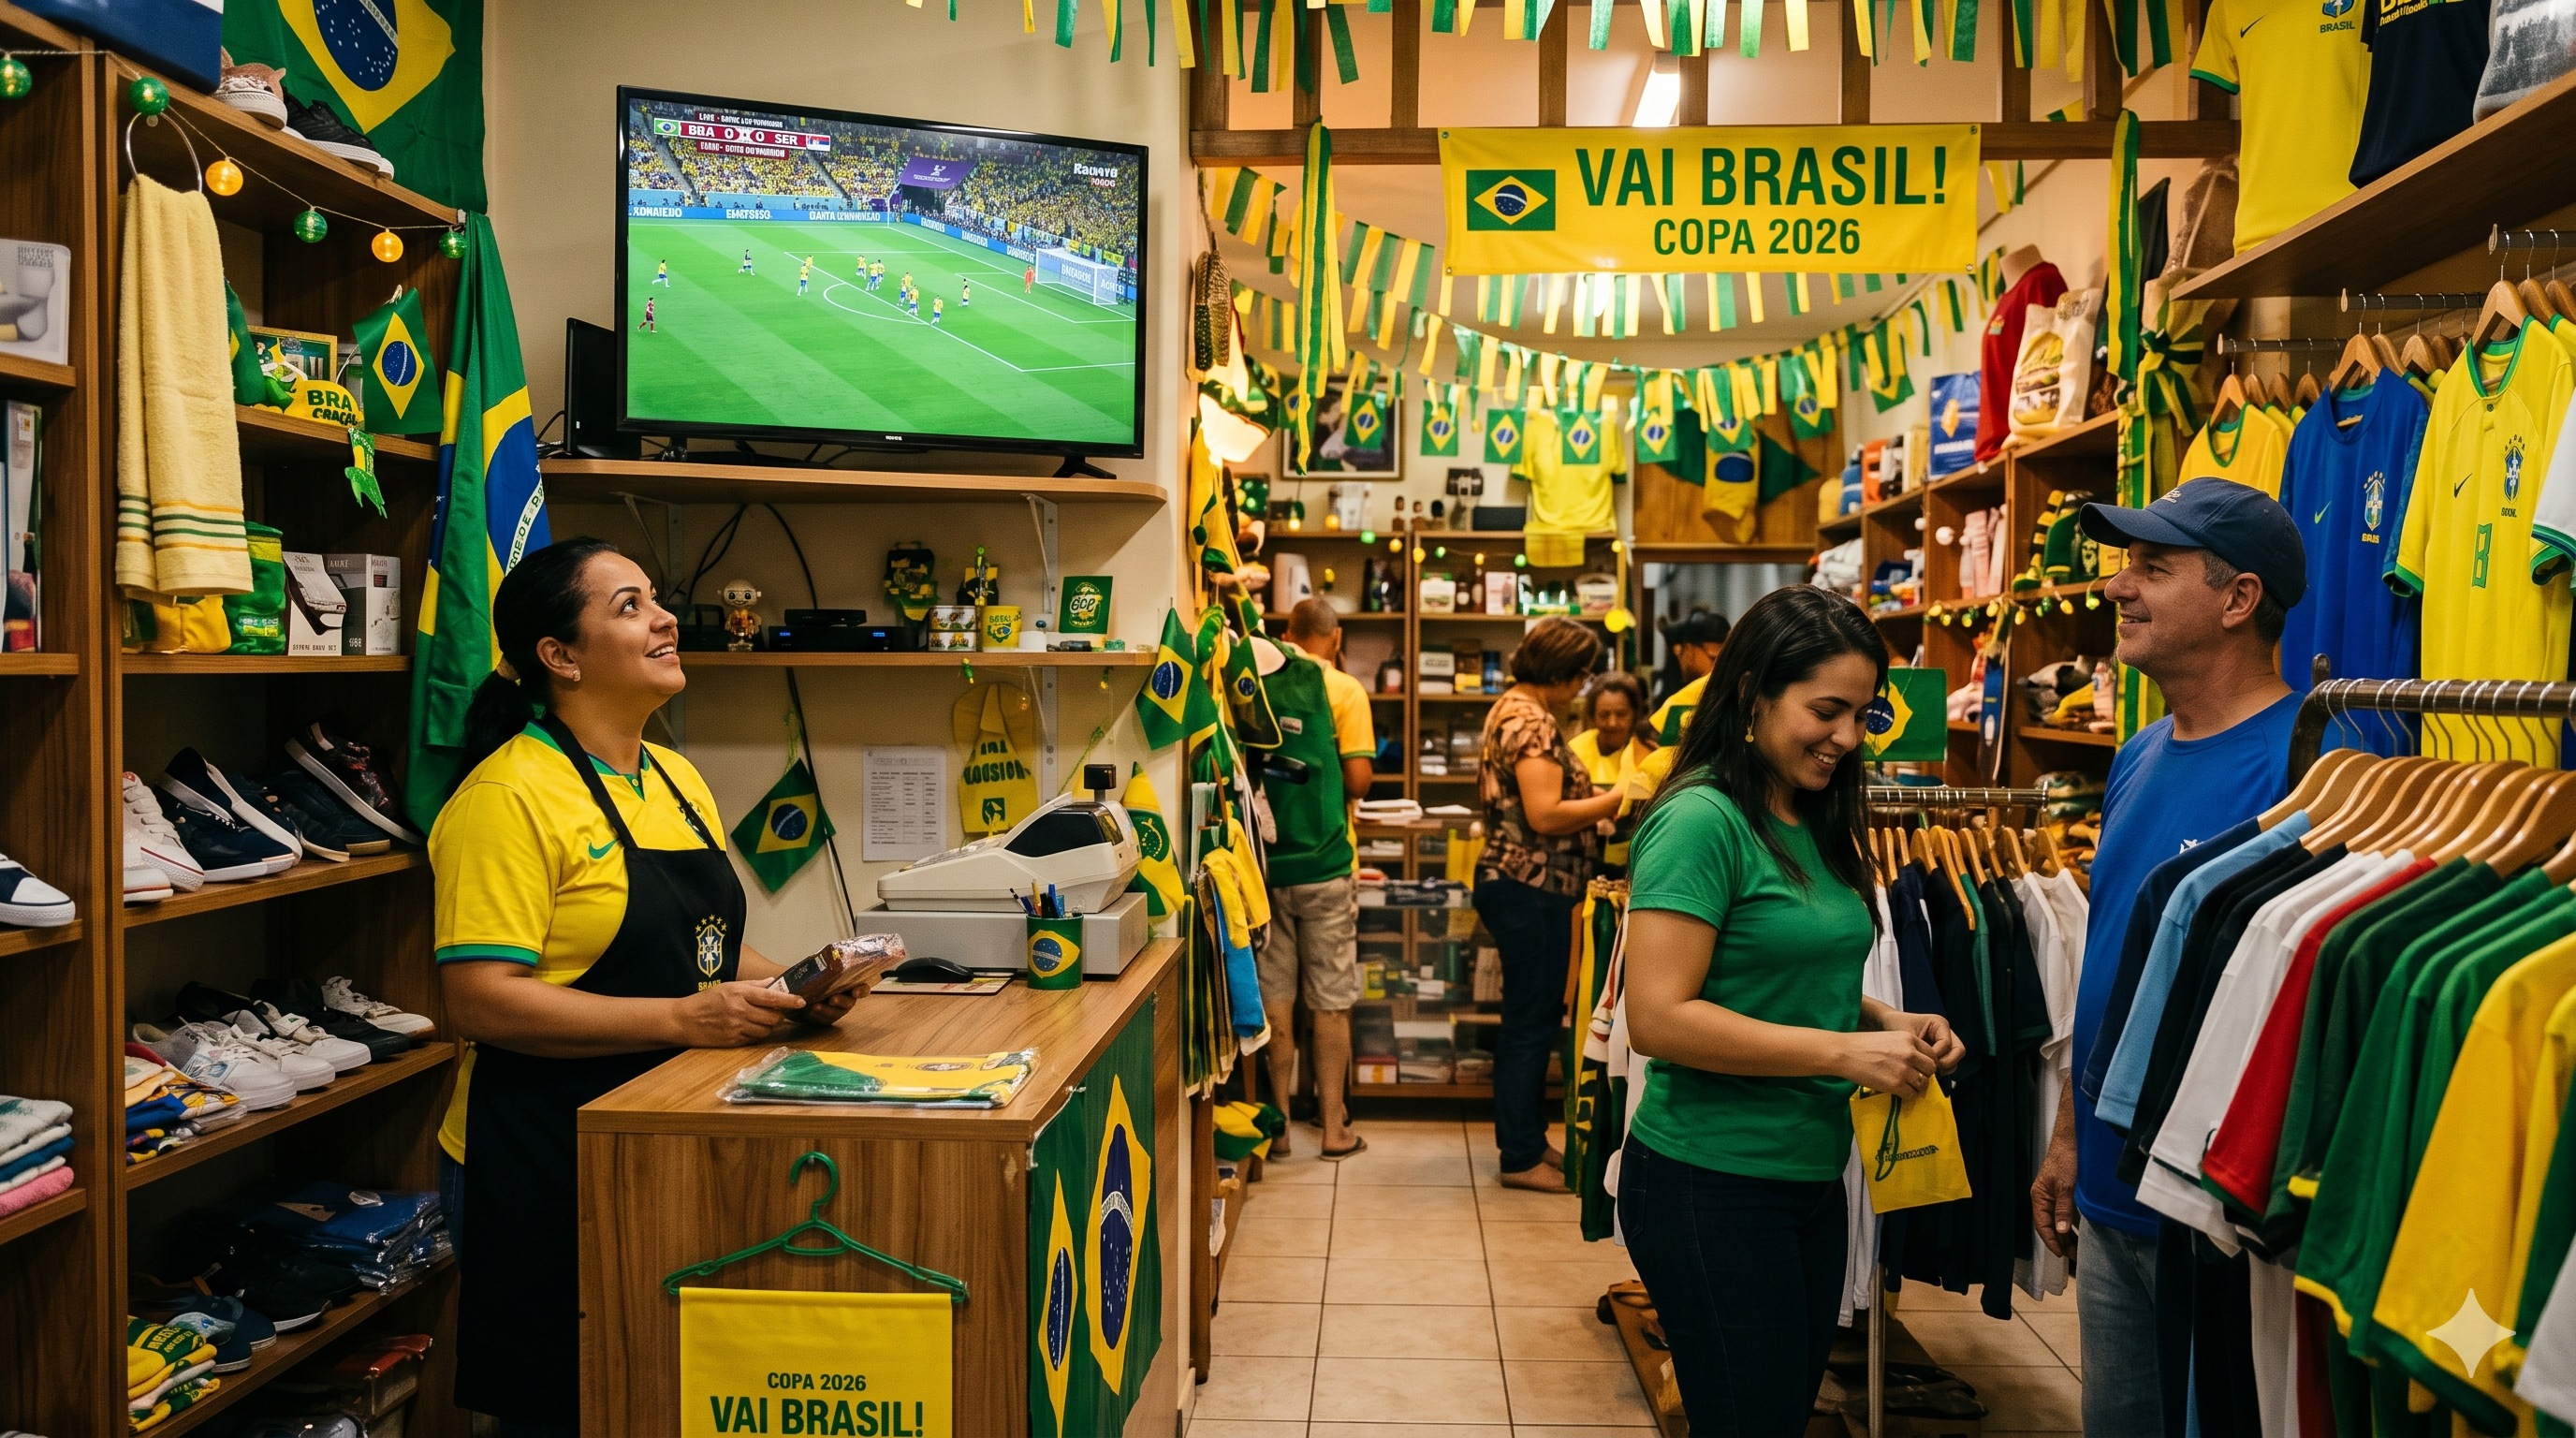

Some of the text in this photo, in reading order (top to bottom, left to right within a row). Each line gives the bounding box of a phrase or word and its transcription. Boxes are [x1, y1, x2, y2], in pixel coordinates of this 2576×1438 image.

[2320, 21, 2355, 33] BRASIL
[688, 125, 798, 146] BRA 0 0 SER
[1574, 146, 1946, 206] VAI BRASIL!
[1654, 218, 1860, 255] COPA 2026
[307, 389, 353, 412] BRA
[767, 1372, 867, 1392] COPA 2026
[710, 1395, 923, 1438] VAI BRASIL!
